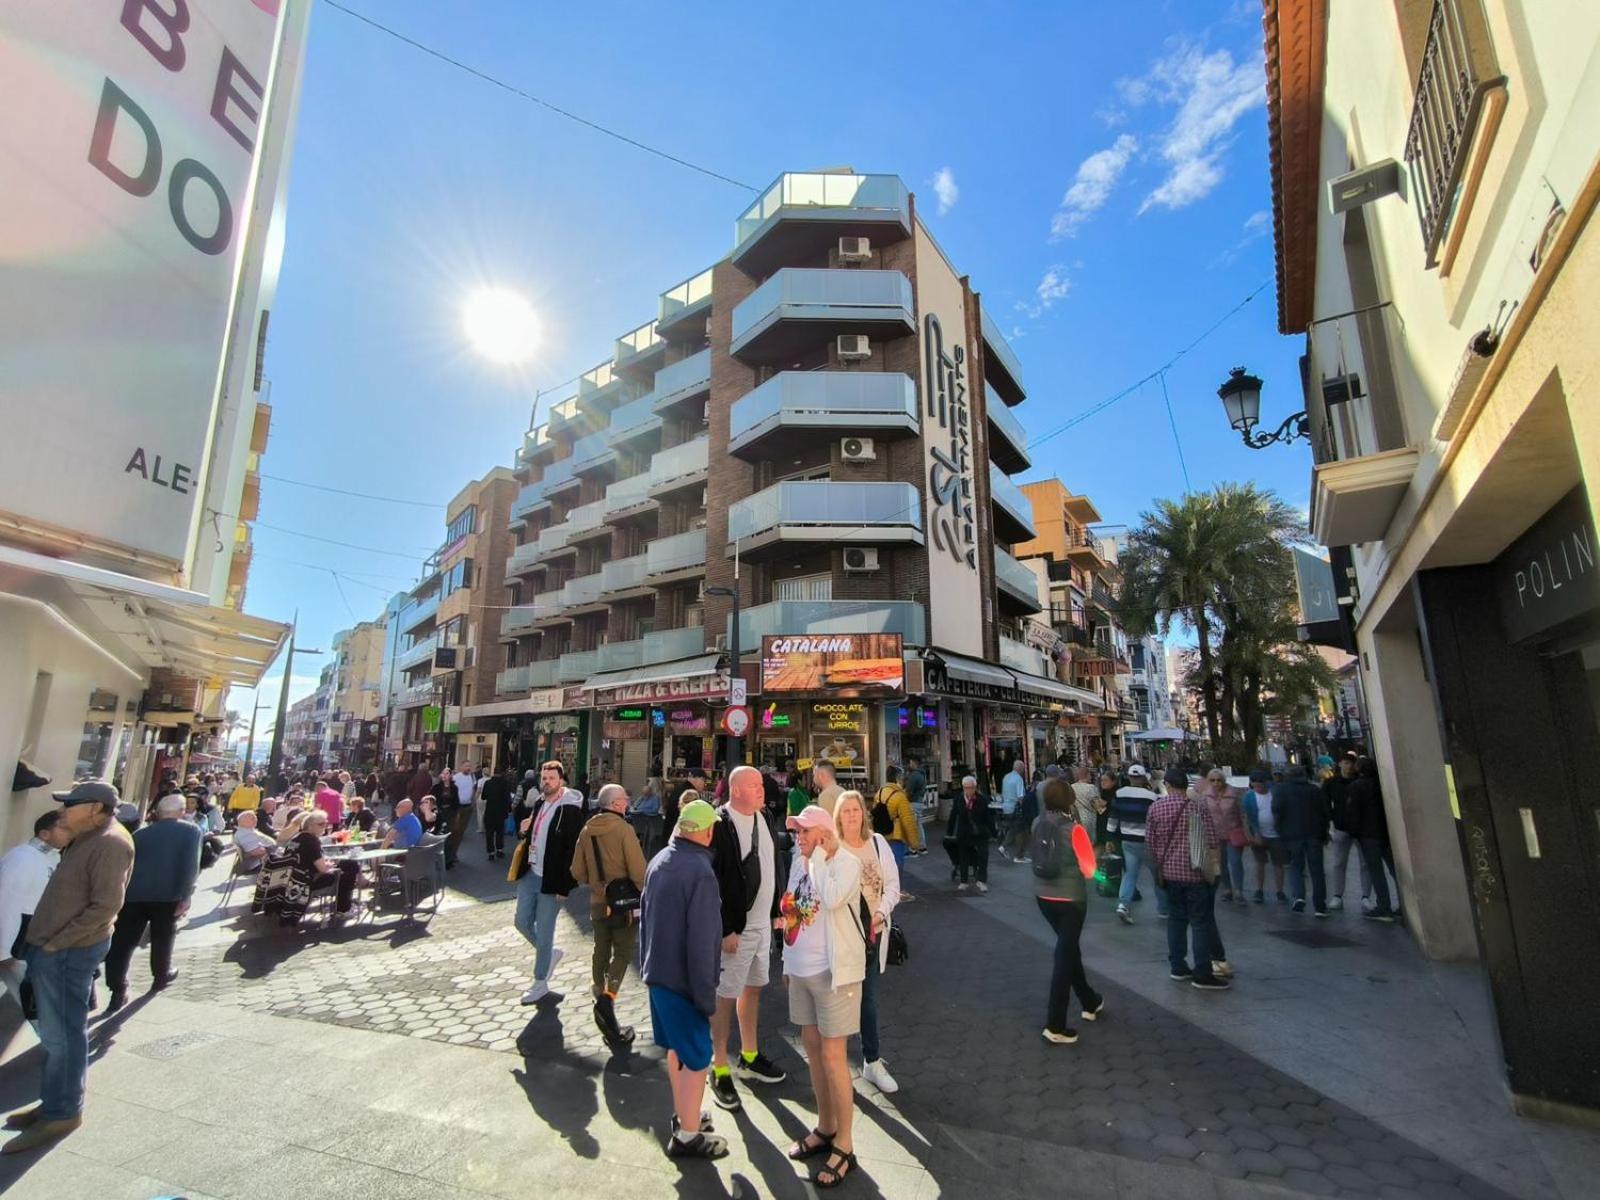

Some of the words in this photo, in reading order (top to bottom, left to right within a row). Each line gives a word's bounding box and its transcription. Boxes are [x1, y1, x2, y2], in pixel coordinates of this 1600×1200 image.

[88, 77, 234, 256] DO
[954, 344, 977, 571] APARTMENTS
[1515, 524, 1595, 608] POLIN
[770, 637, 852, 654] CATALANA
[1079, 660, 1114, 675] TATTOO
[813, 704, 864, 712] CHOCOLATE
[829, 712, 848, 720] CON
